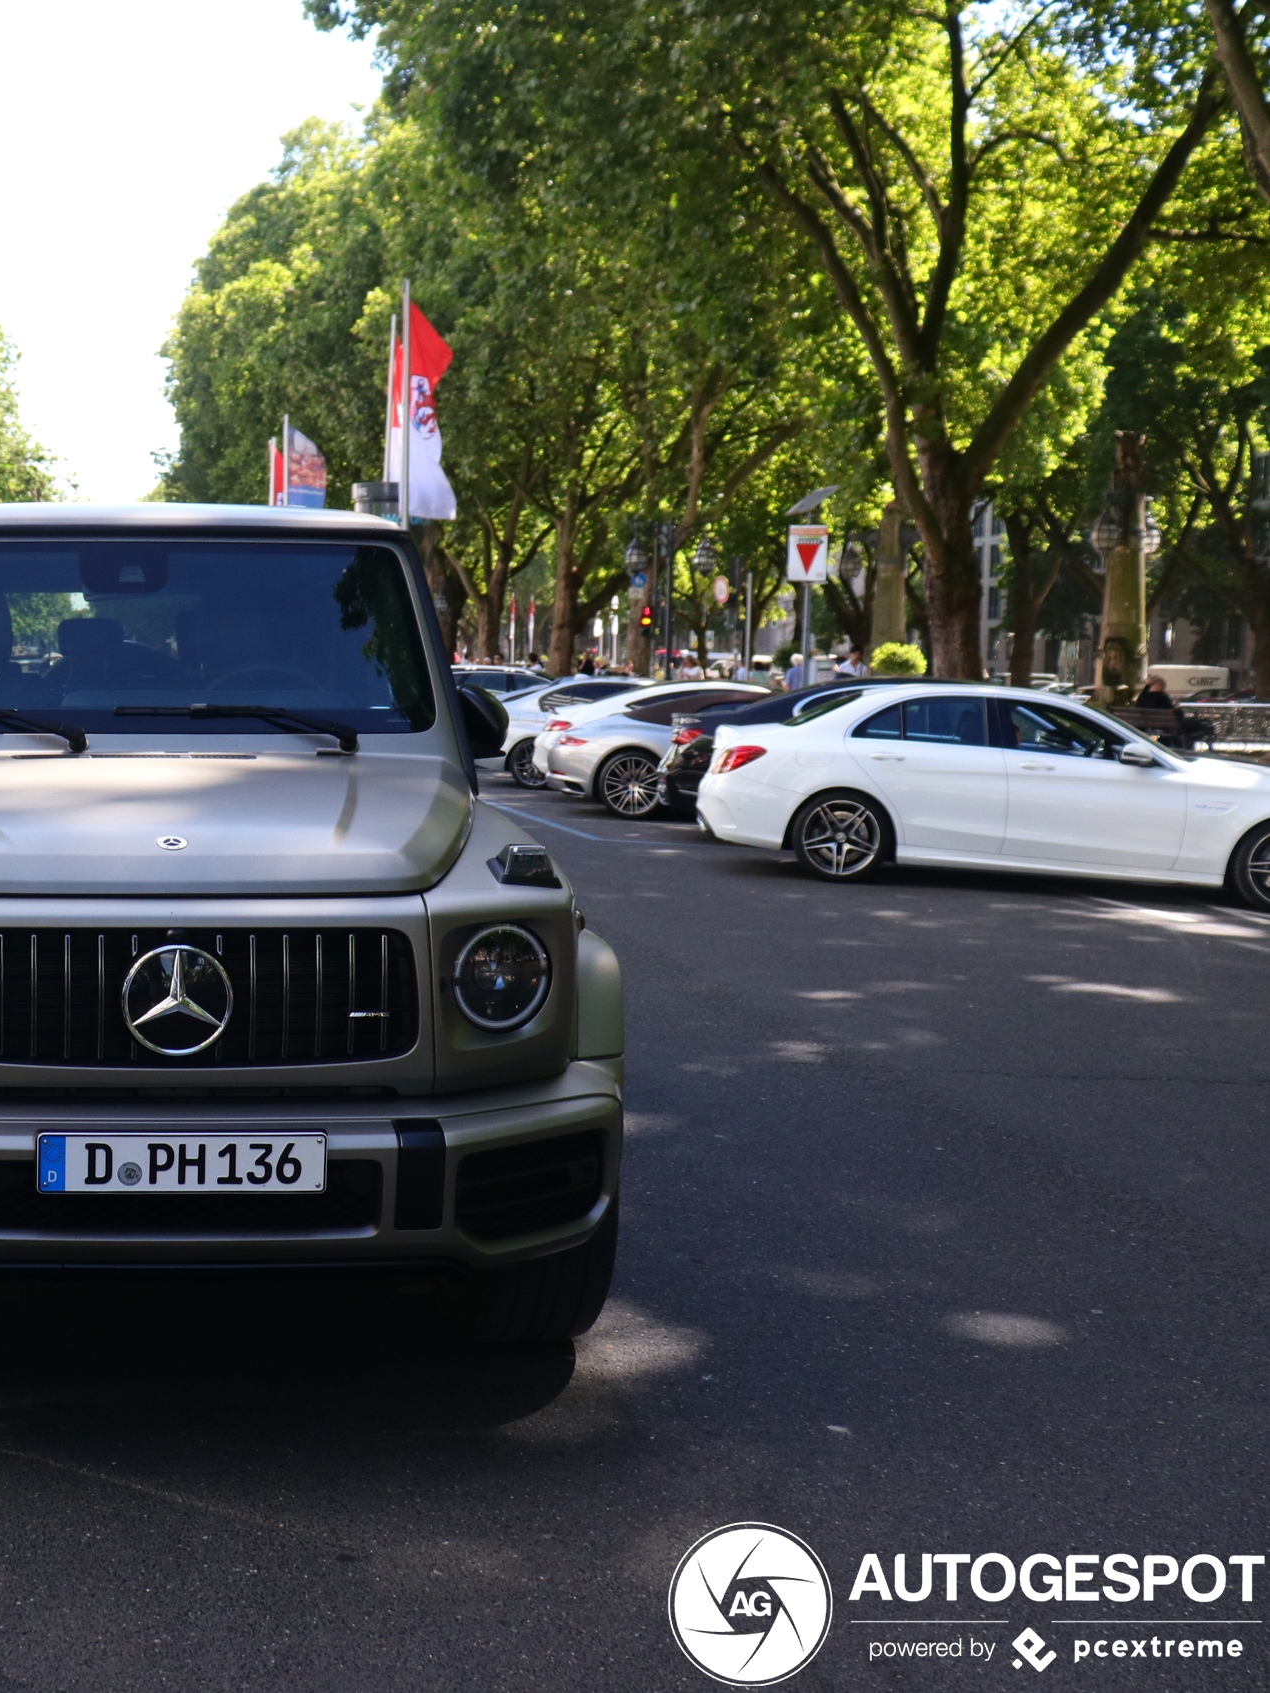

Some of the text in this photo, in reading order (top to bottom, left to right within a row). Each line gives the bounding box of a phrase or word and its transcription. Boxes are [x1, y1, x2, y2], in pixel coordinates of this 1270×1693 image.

[46, 1170, 58, 1182] D
[84, 1142, 302, 1185] D PH 136
